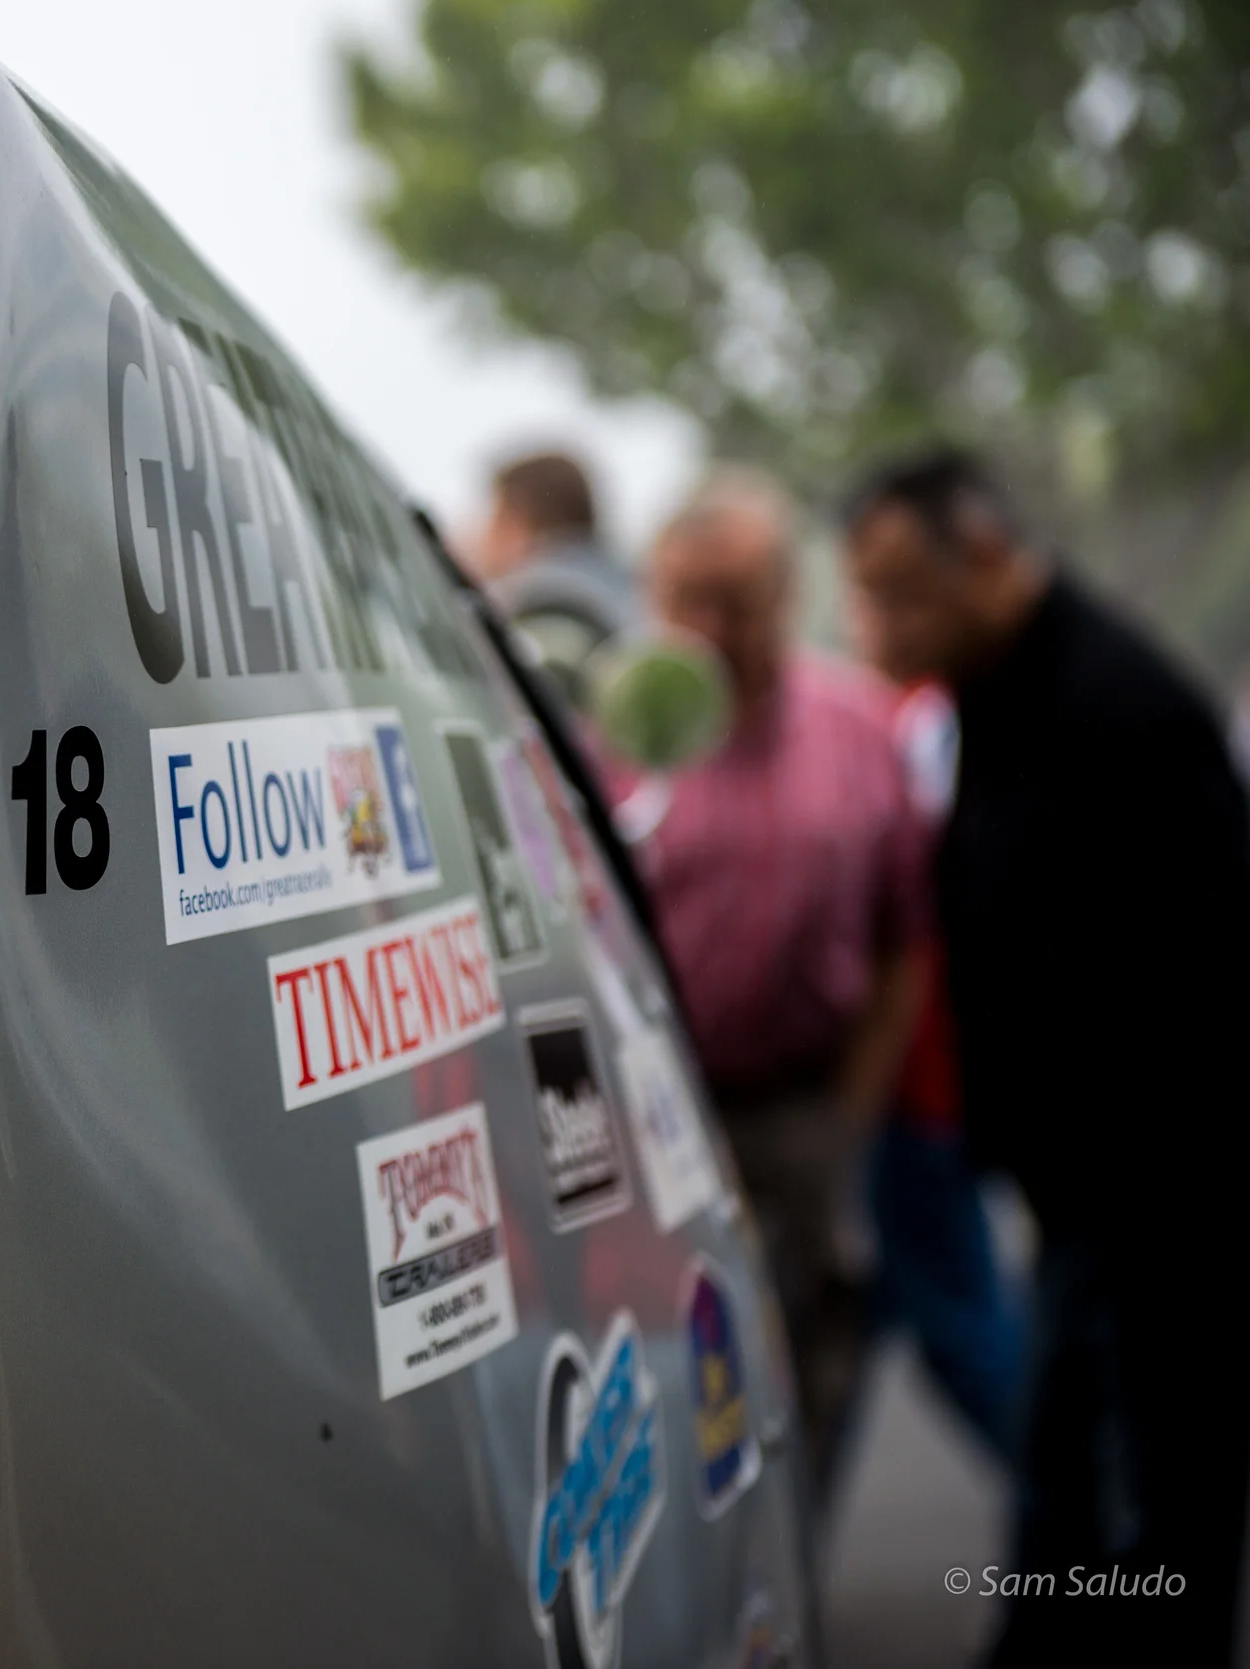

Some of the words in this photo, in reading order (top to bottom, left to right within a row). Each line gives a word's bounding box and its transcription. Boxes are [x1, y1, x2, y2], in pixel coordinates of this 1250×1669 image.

[11, 725, 110, 895] 18
[168, 740, 327, 874] Follow
[275, 913, 501, 1089] TIMEWISE
